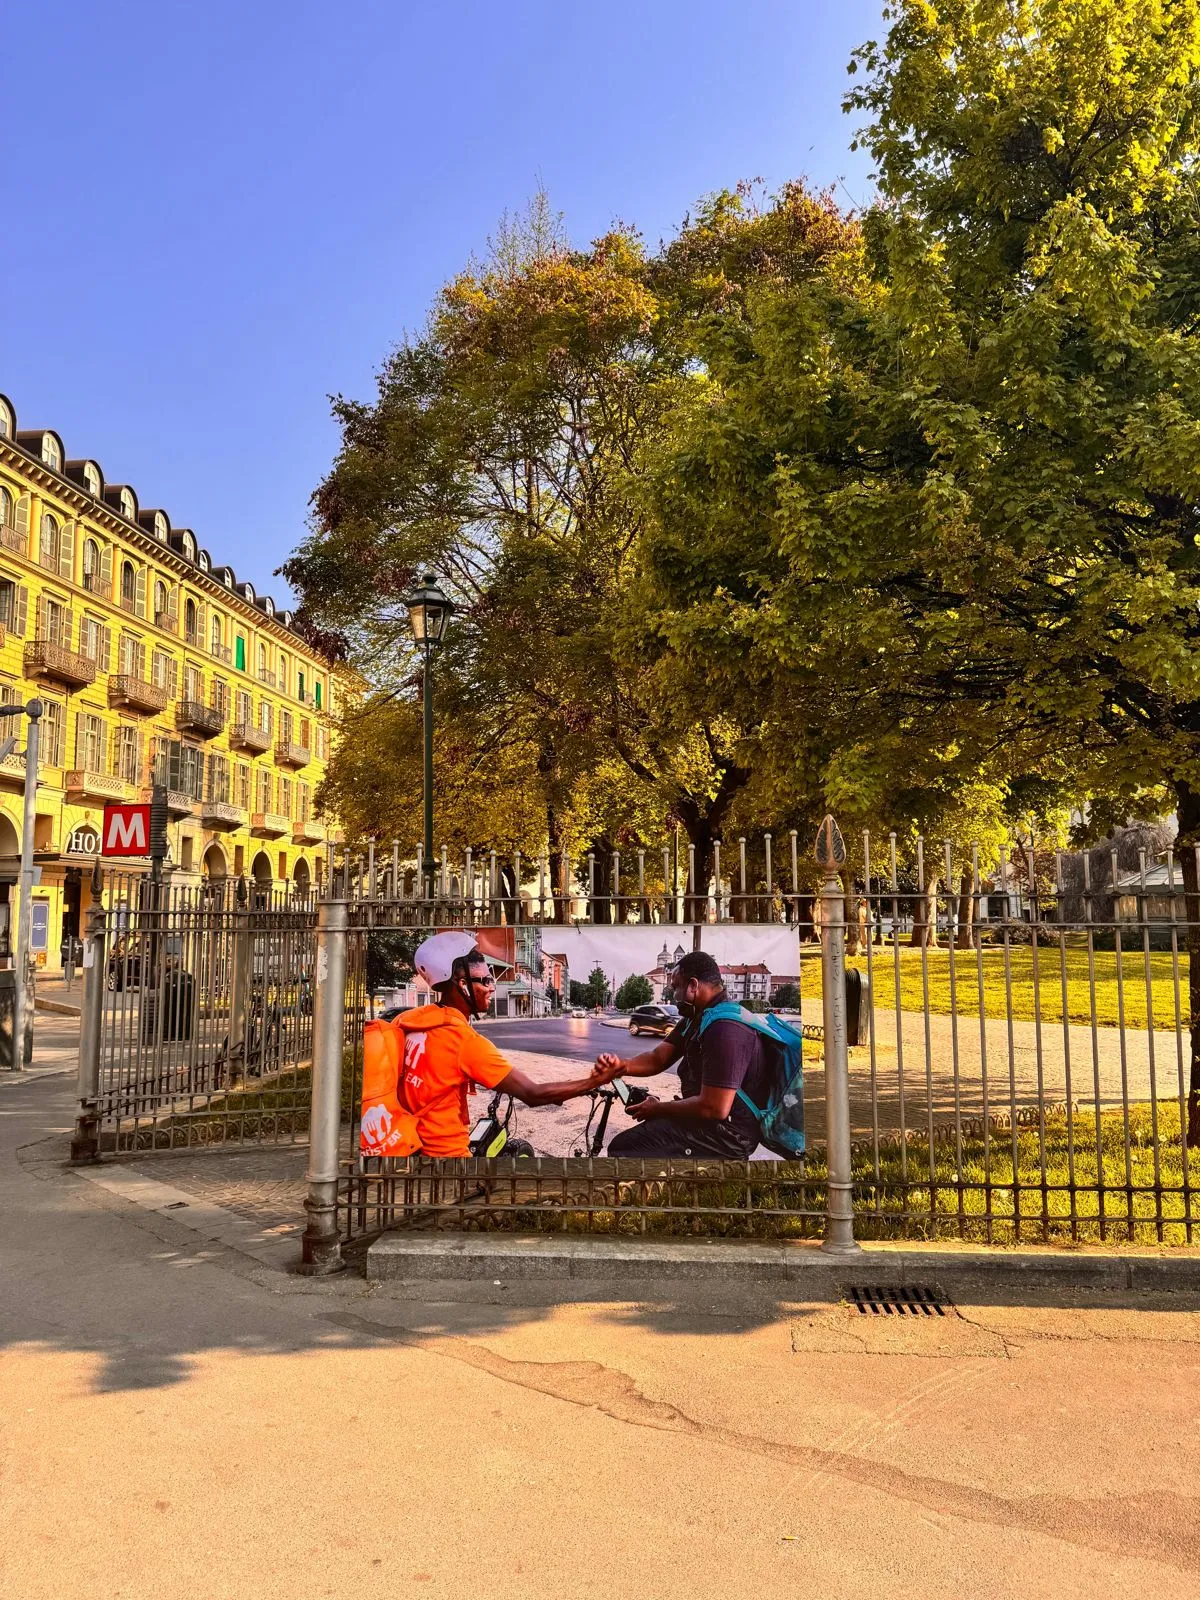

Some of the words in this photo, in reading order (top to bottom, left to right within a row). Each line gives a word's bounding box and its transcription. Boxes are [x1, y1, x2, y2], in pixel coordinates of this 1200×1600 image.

[106, 813, 146, 848] M
[406, 1072, 423, 1088] EAT
[386, 1128, 402, 1147] EAT
